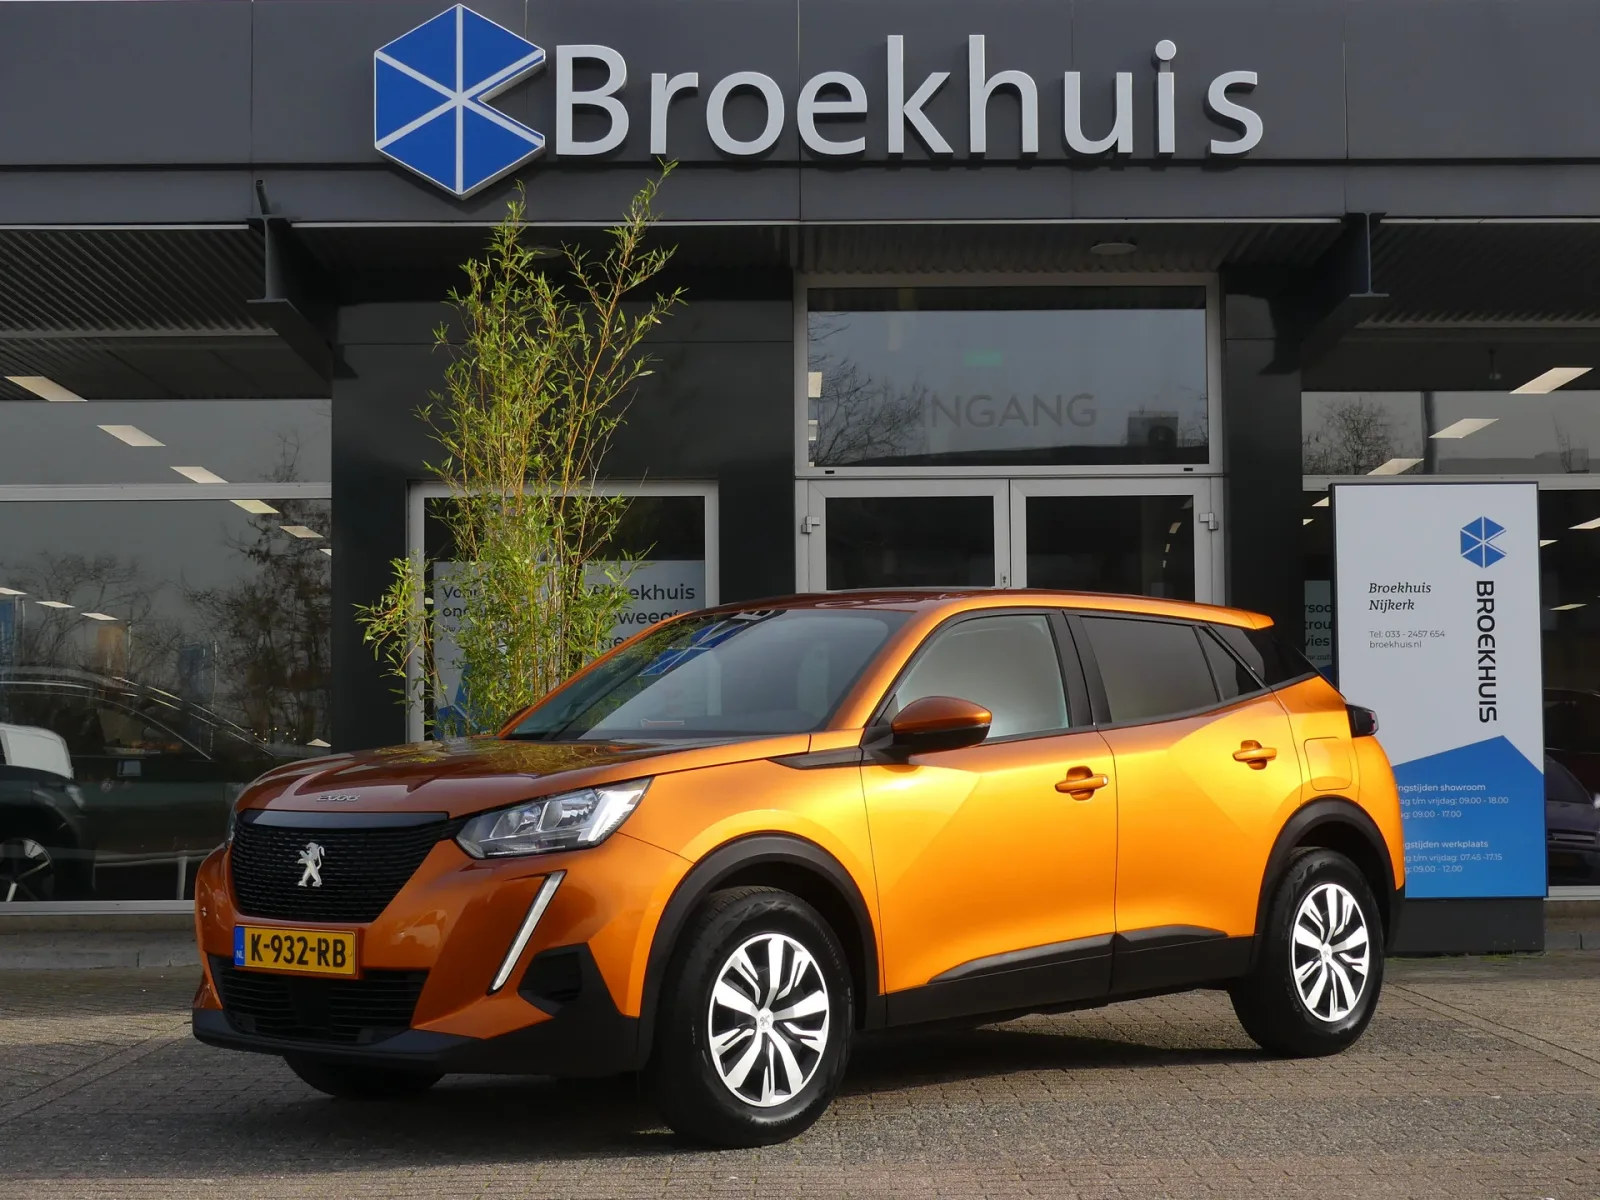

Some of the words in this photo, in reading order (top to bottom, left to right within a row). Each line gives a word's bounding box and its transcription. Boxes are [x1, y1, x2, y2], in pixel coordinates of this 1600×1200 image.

[555, 34, 1264, 157] Broekhuis
[1368, 582, 1432, 594] Broekhuis
[1368, 599, 1415, 613] Nijkerk
[1369, 630, 1383, 638] Tel:
[1385, 630, 1400, 638] 033
[1408, 630, 1428, 638] 2457
[1429, 630, 1445, 638] 654
[1369, 640, 1422, 649] broekhuis.nl
[1476, 580, 1497, 723] BROEKHUIS
[1412, 797, 1426, 805] t/m
[1427, 797, 1458, 807] vrijdag:
[1488, 796, 1509, 804] 18.00
[1441, 840, 1489, 849] werkplaats
[236, 950, 244, 959] NL
[251, 933, 346, 968] K-932-RB
